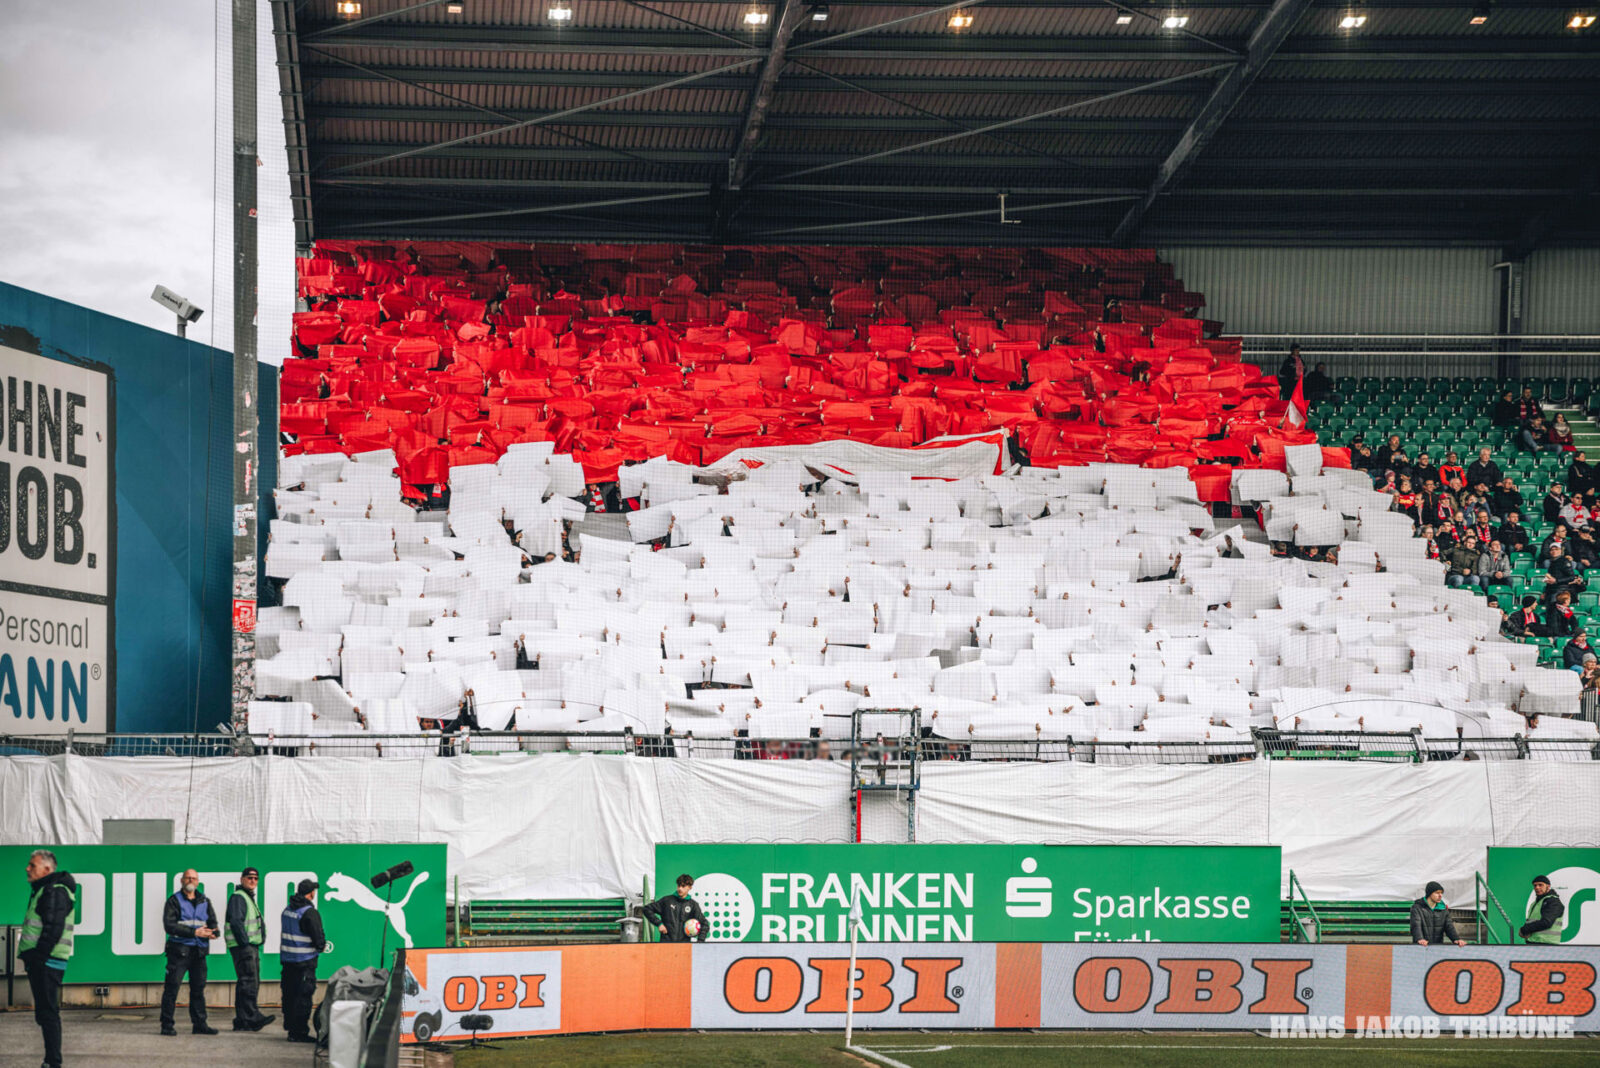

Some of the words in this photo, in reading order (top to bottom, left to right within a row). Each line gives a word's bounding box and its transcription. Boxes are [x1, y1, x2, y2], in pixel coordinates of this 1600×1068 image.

[0, 376, 87, 469] HNE
[761, 872, 975, 909] FRANKEN
[1072, 886, 1251, 926] Sparkasse
[1423, 958, 1598, 1017] OB
